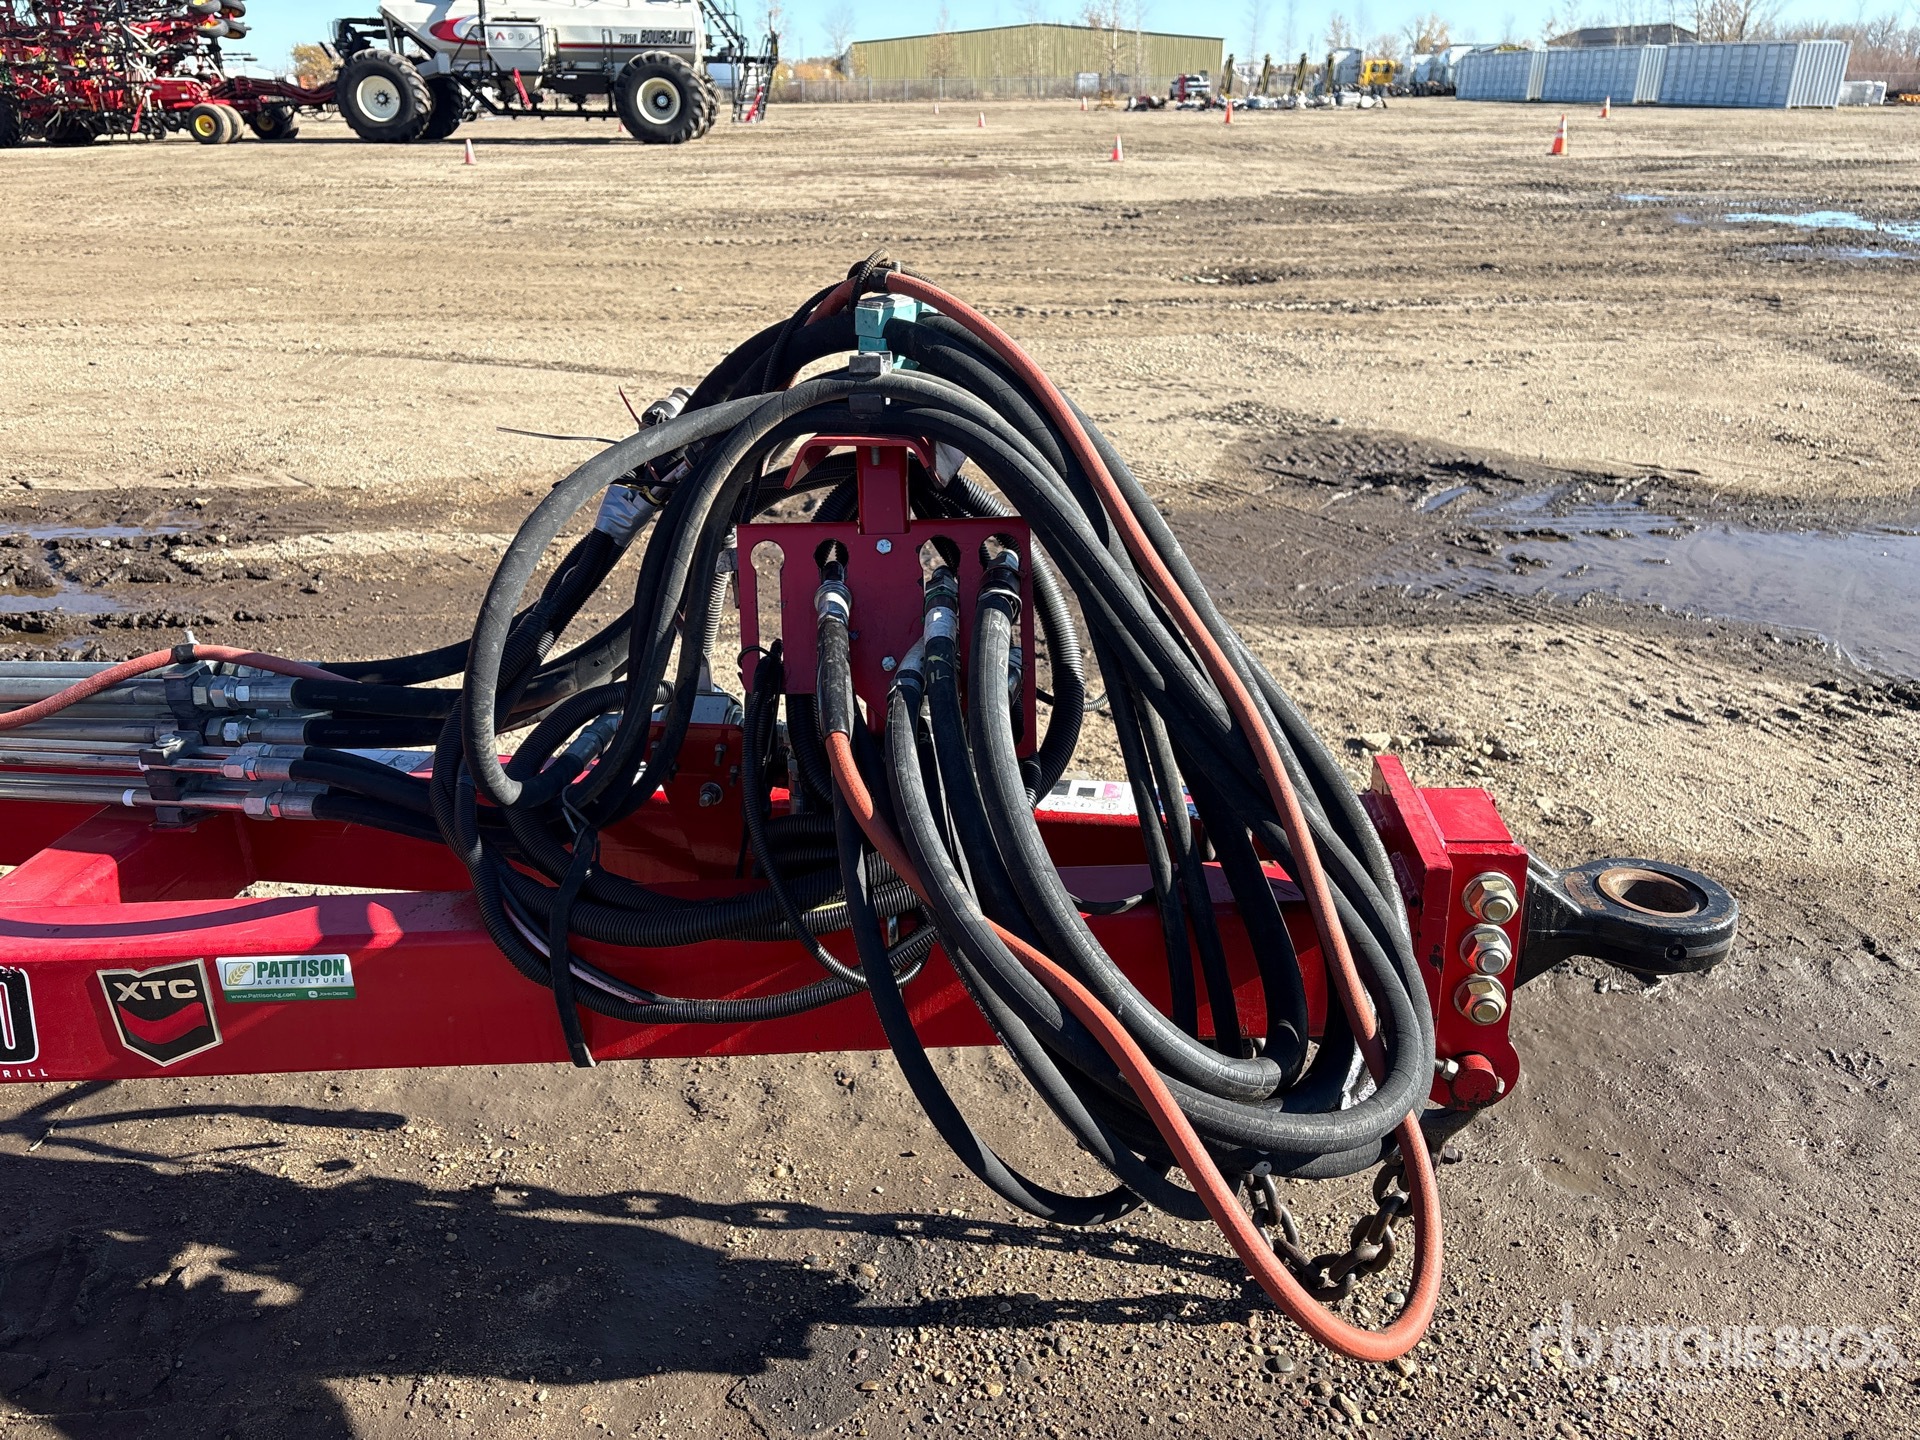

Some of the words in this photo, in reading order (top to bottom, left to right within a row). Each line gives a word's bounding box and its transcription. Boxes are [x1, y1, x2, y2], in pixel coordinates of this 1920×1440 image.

[640, 29, 693, 45] BOURGAULT
[256, 958, 345, 979] PATTISON
[257, 977, 346, 986] AGRICULTURE
[113, 979, 198, 1002] XTC
[230, 991, 297, 1000] www.PattisonAg.com
